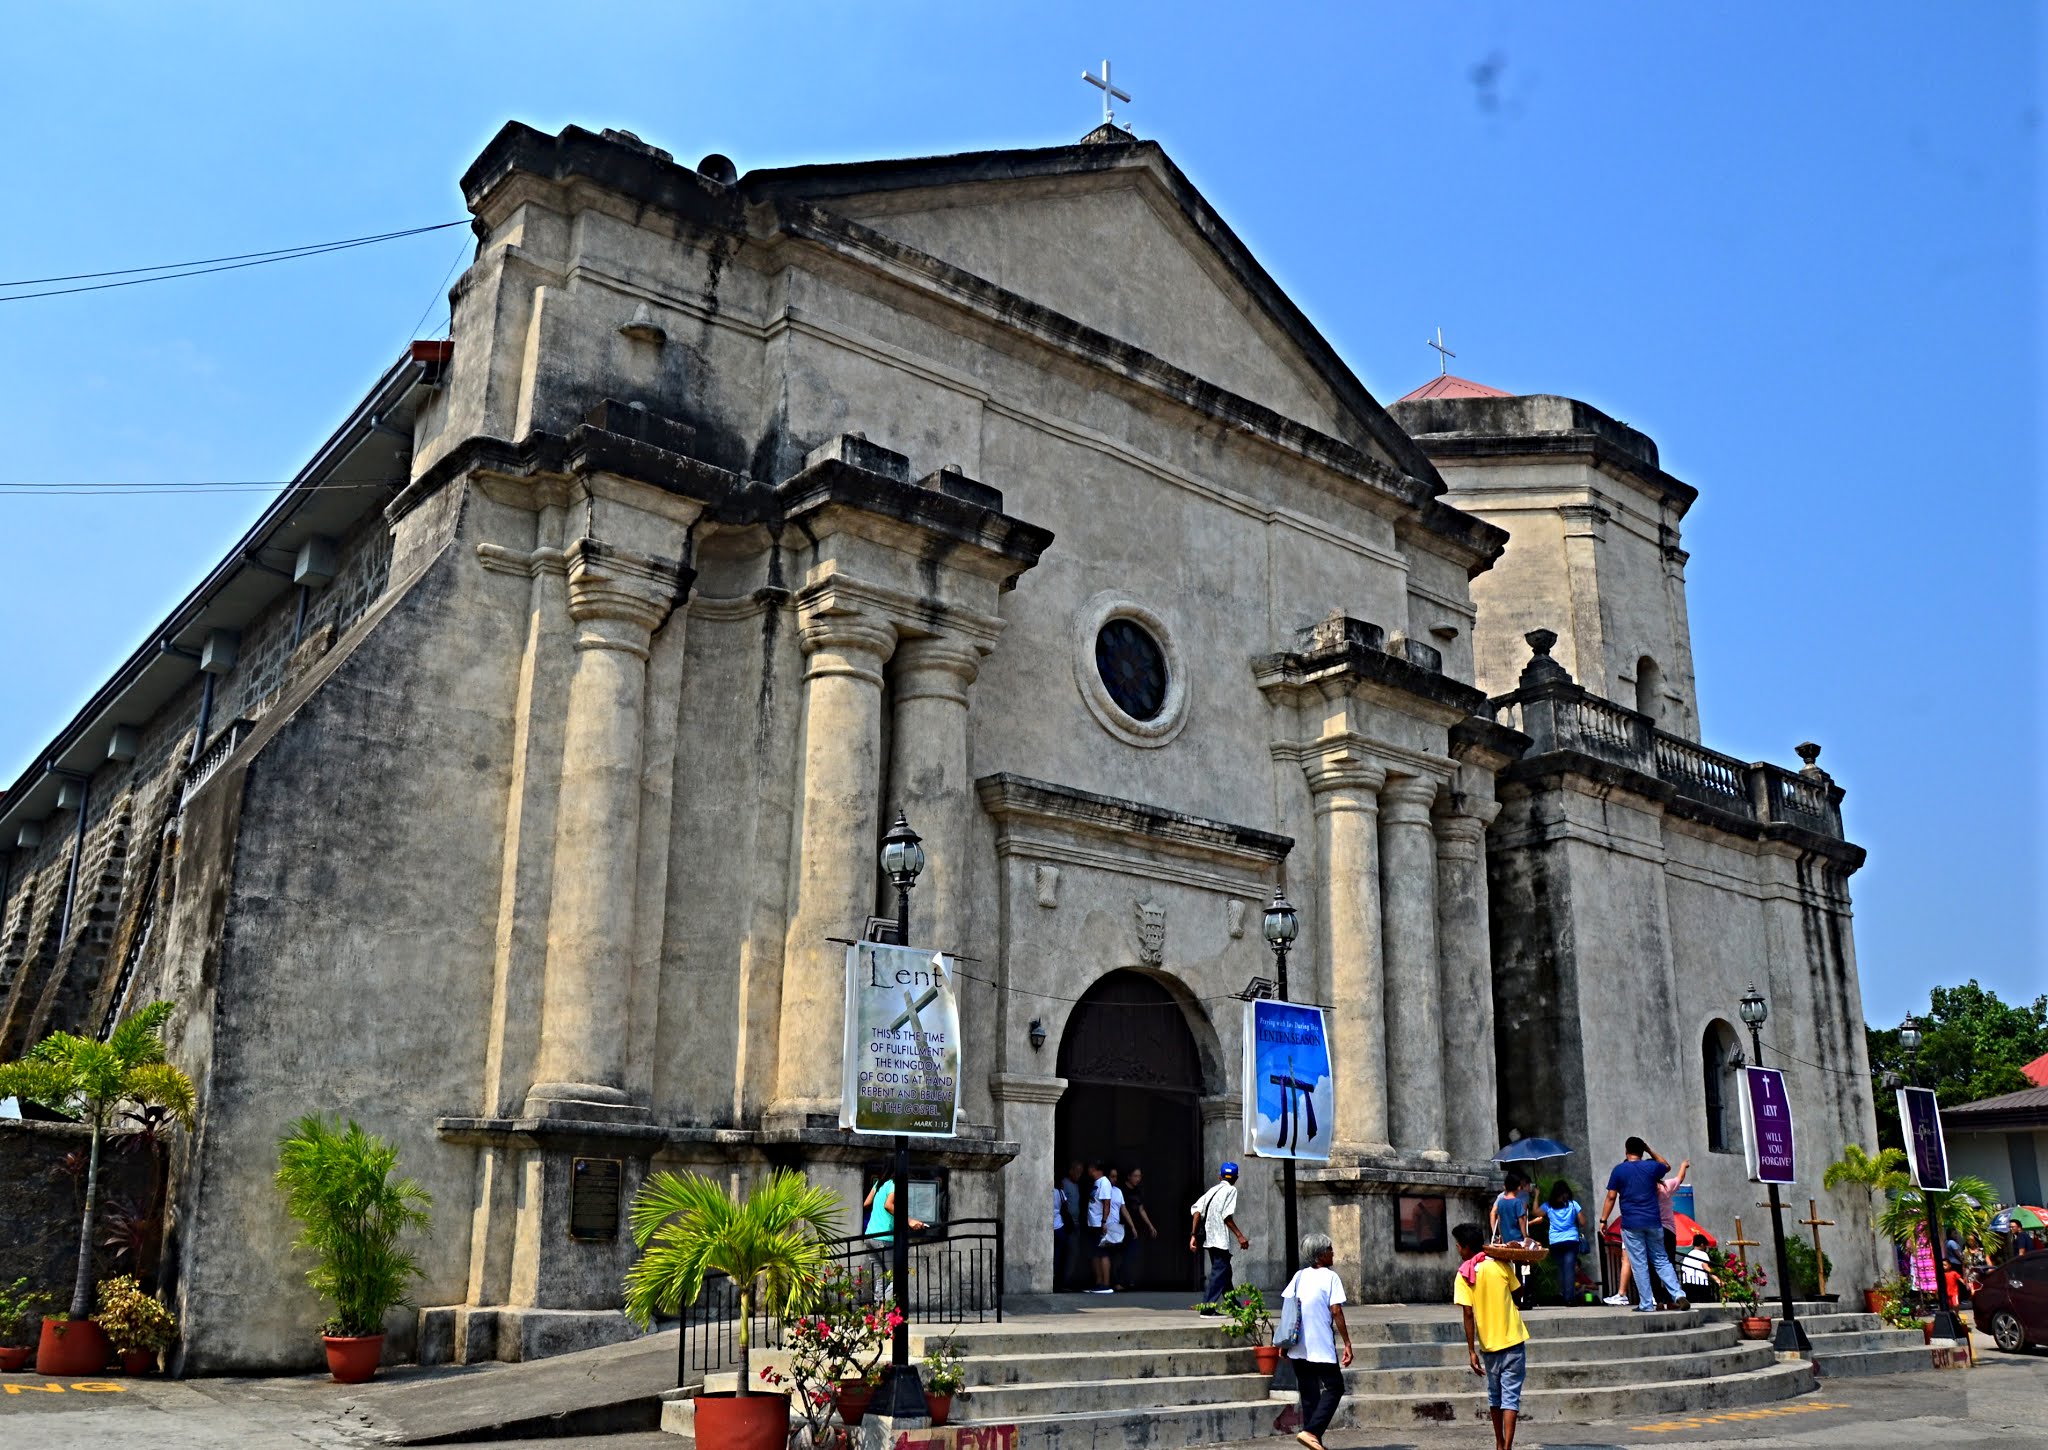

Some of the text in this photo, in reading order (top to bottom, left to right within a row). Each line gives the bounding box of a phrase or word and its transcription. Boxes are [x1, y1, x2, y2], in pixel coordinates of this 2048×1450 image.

[871, 951, 942, 988] Lent
[1295, 1021, 1310, 1031] During
[872, 1028, 945, 1043] THIS IS THE TIME
[1260, 1029, 1320, 1046] LENTEN SEASON
[871, 1043, 884, 1053] OF
[875, 1058, 942, 1071] THE KINGDOM
[860, 1072, 953, 1087] OF GOD IS AT HAND
[862, 1087, 953, 1102] REPENT AND BELIEVE
[872, 1101, 883, 1113] IN
[885, 1102, 902, 1113] THE
[1763, 1105, 1777, 1117] LENT
[934, 1121, 949, 1129] 1:15
[1765, 1132, 1783, 1142] WILL
[1768, 1144, 1782, 1154] YOU
[1761, 1156, 1792, 1167] FORGIVE?
[956, 1424, 1016, 1450] EXIT
